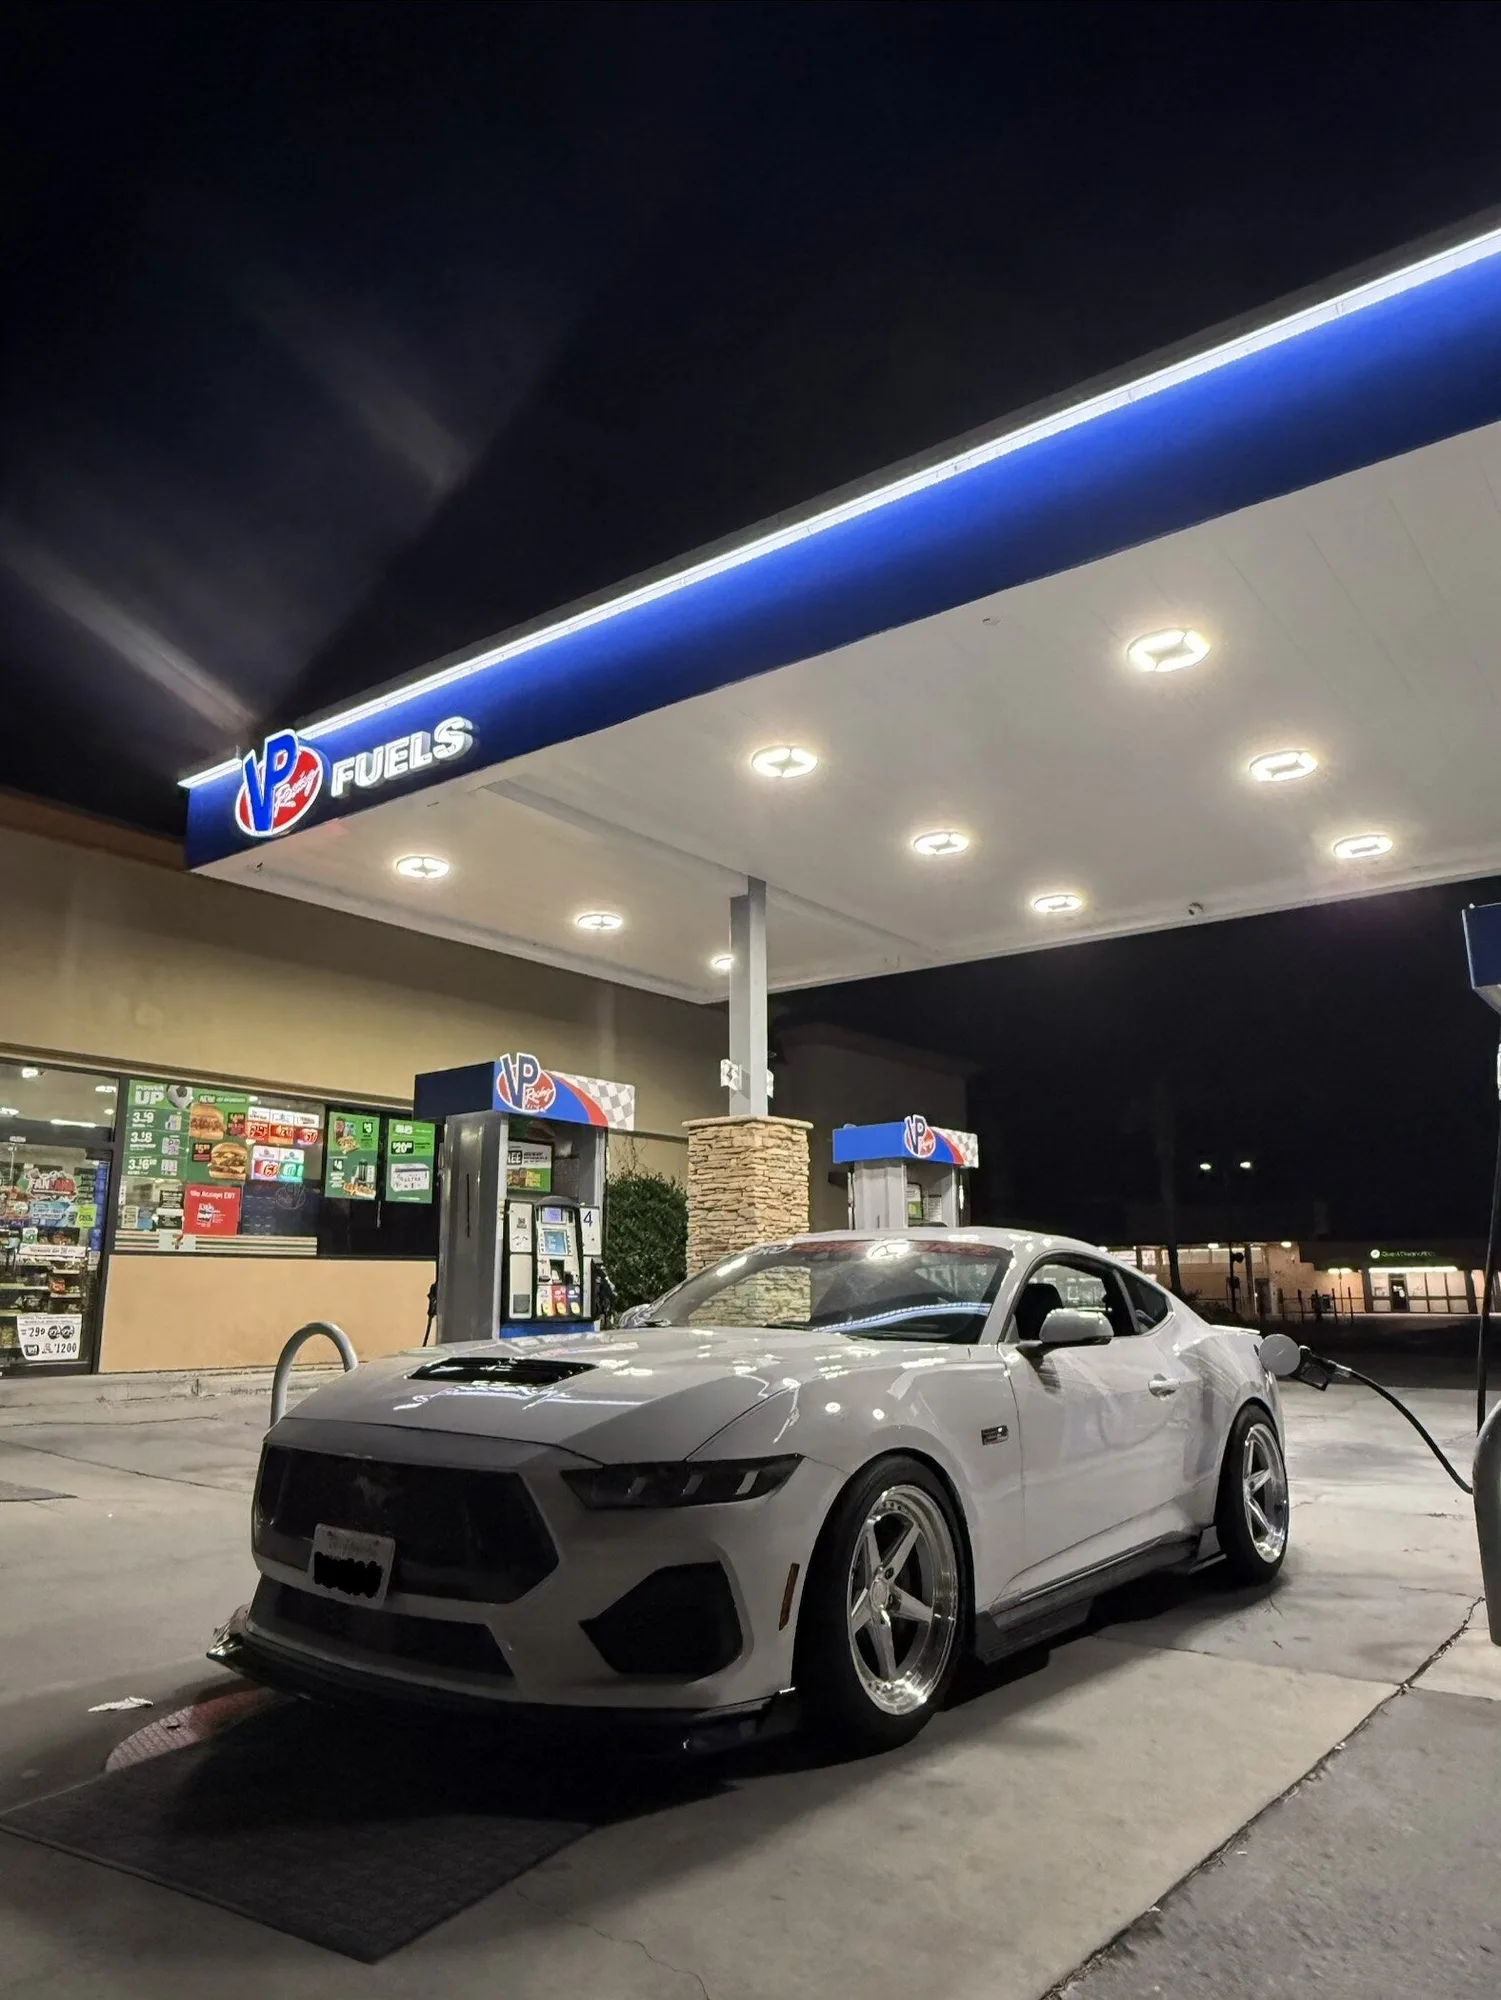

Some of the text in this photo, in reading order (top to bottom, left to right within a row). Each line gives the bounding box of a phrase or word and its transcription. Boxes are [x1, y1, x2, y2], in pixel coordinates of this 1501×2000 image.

[243, 729, 298, 831] VP
[331, 716, 474, 799] FUELS
[135, 1091, 165, 1105] UP
[500, 1052, 541, 1110] VP
[904, 1114, 926, 1154] VP
[583, 1210, 593, 1228] 4
